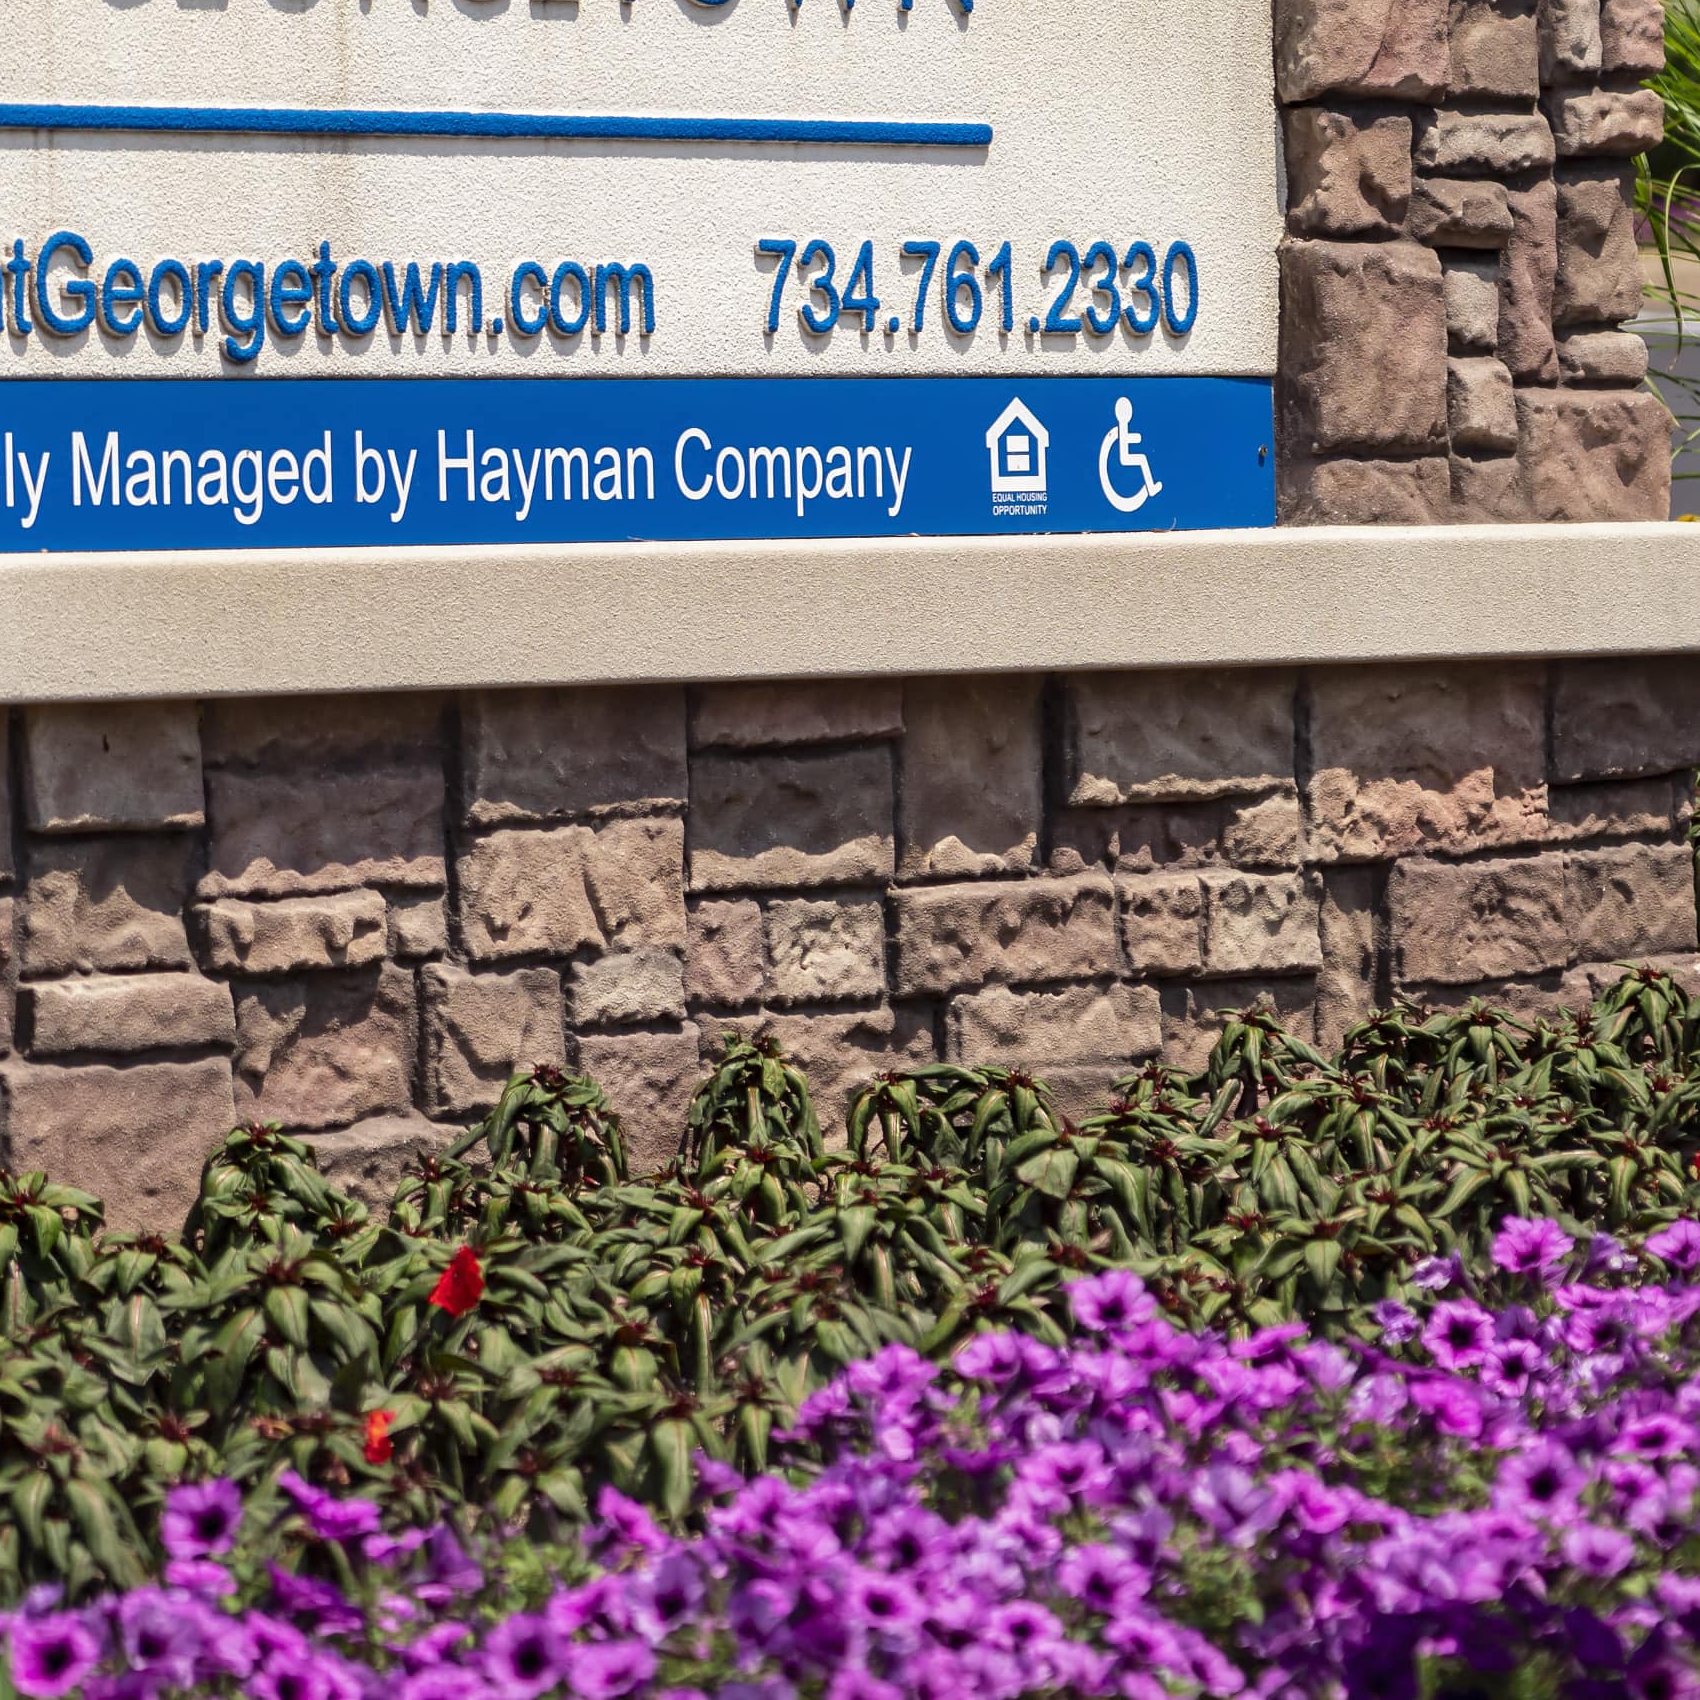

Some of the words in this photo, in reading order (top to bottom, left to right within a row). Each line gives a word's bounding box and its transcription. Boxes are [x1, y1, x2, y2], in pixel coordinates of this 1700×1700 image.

[757, 238, 1199, 334] 734.761.2330
[71, 430, 333, 525] Managed
[355, 429, 418, 523] by
[437, 429, 655, 522] Hayman
[674, 427, 912, 517] Company
[992, 493, 1015, 503] EQUAL
[1016, 492, 1047, 502] HOUSING
[992, 504, 1047, 516] OPPORTUNITY
